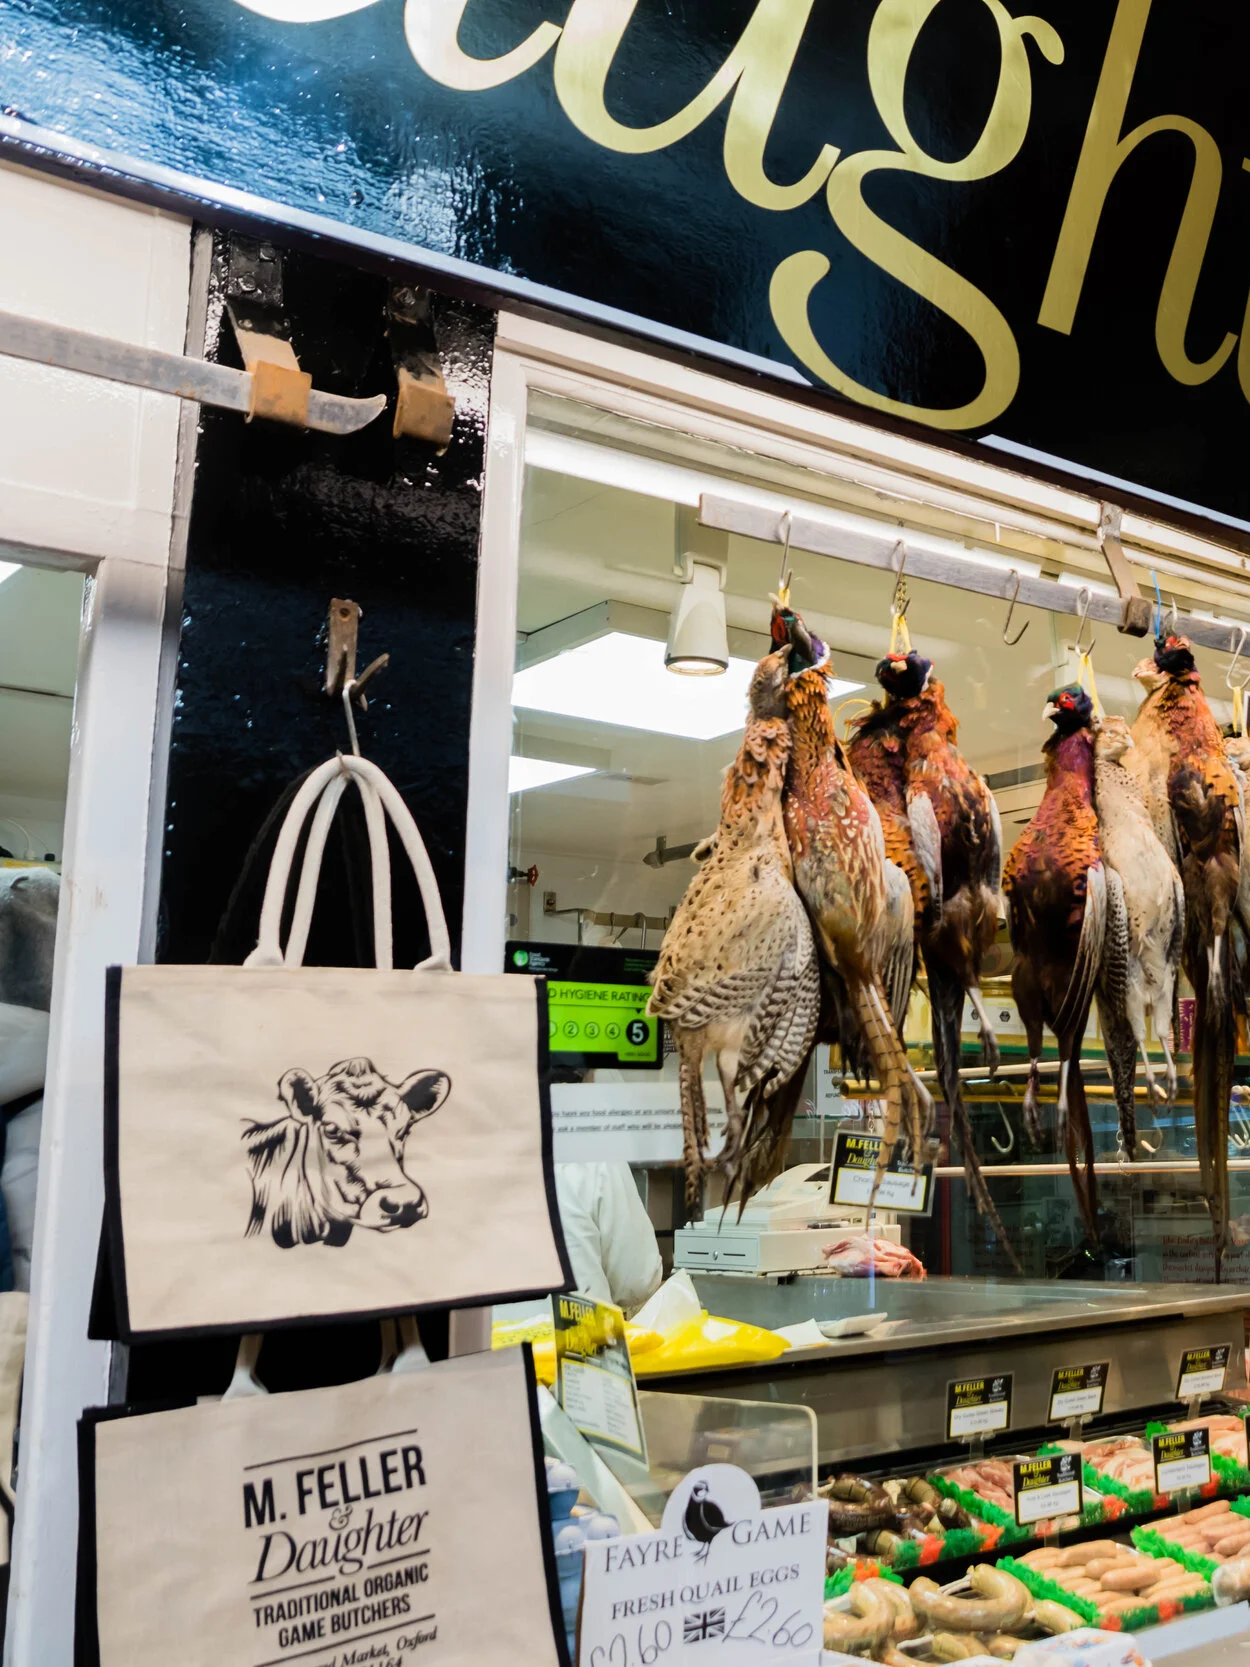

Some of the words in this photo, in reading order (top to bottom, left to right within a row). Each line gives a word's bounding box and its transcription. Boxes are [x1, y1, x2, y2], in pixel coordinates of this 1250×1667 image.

[560, 988, 609, 1001] HYGIENE
[611, 991, 651, 1003] RATING
[631, 1022, 644, 1043] 5
[955, 1381, 984, 1394] M.FELLER
[243, 1477, 287, 1529] M.
[296, 1444, 427, 1516] FELLER
[1020, 1460, 1051, 1474] M.FELLER
[328, 1503, 353, 1531] &
[247, 1507, 429, 1585] Daughter
[604, 1533, 684, 1573] FAYRE
[731, 1512, 812, 1547] GAME
[253, 1587, 360, 1628] TRADITIONAL
[363, 1562, 429, 1598] ORGANIC
[611, 1590, 675, 1620] FRESH
[680, 1576, 743, 1604] QUAIL
[749, 1563, 801, 1589] EGGS
[278, 1617, 326, 1648] GAME
[331, 1593, 411, 1635] BUTCHERS
[341, 1643, 390, 1667] Market,
[396, 1626, 438, 1651] Oxford
